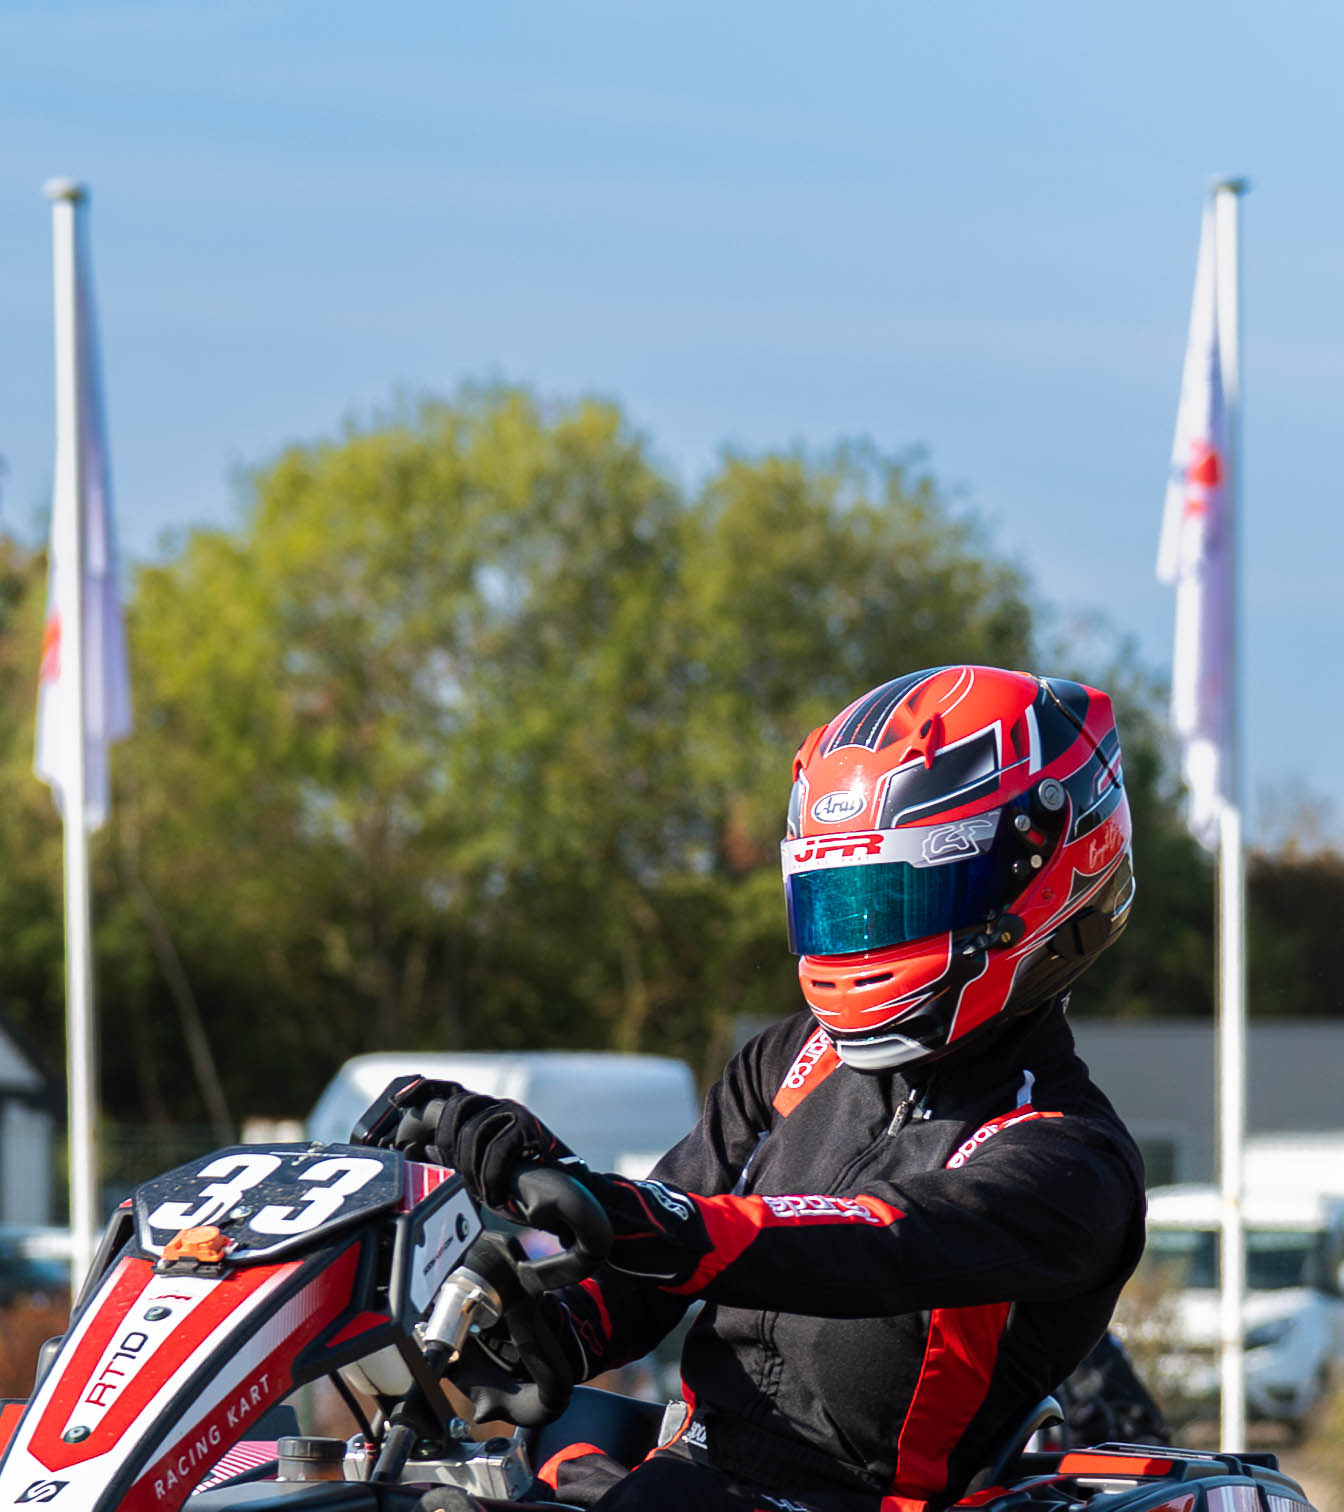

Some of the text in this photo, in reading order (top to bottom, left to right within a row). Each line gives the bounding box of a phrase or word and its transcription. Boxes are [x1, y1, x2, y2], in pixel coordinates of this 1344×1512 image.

[148, 1153, 384, 1235] 33
[154, 1374, 269, 1500] RACING KART
